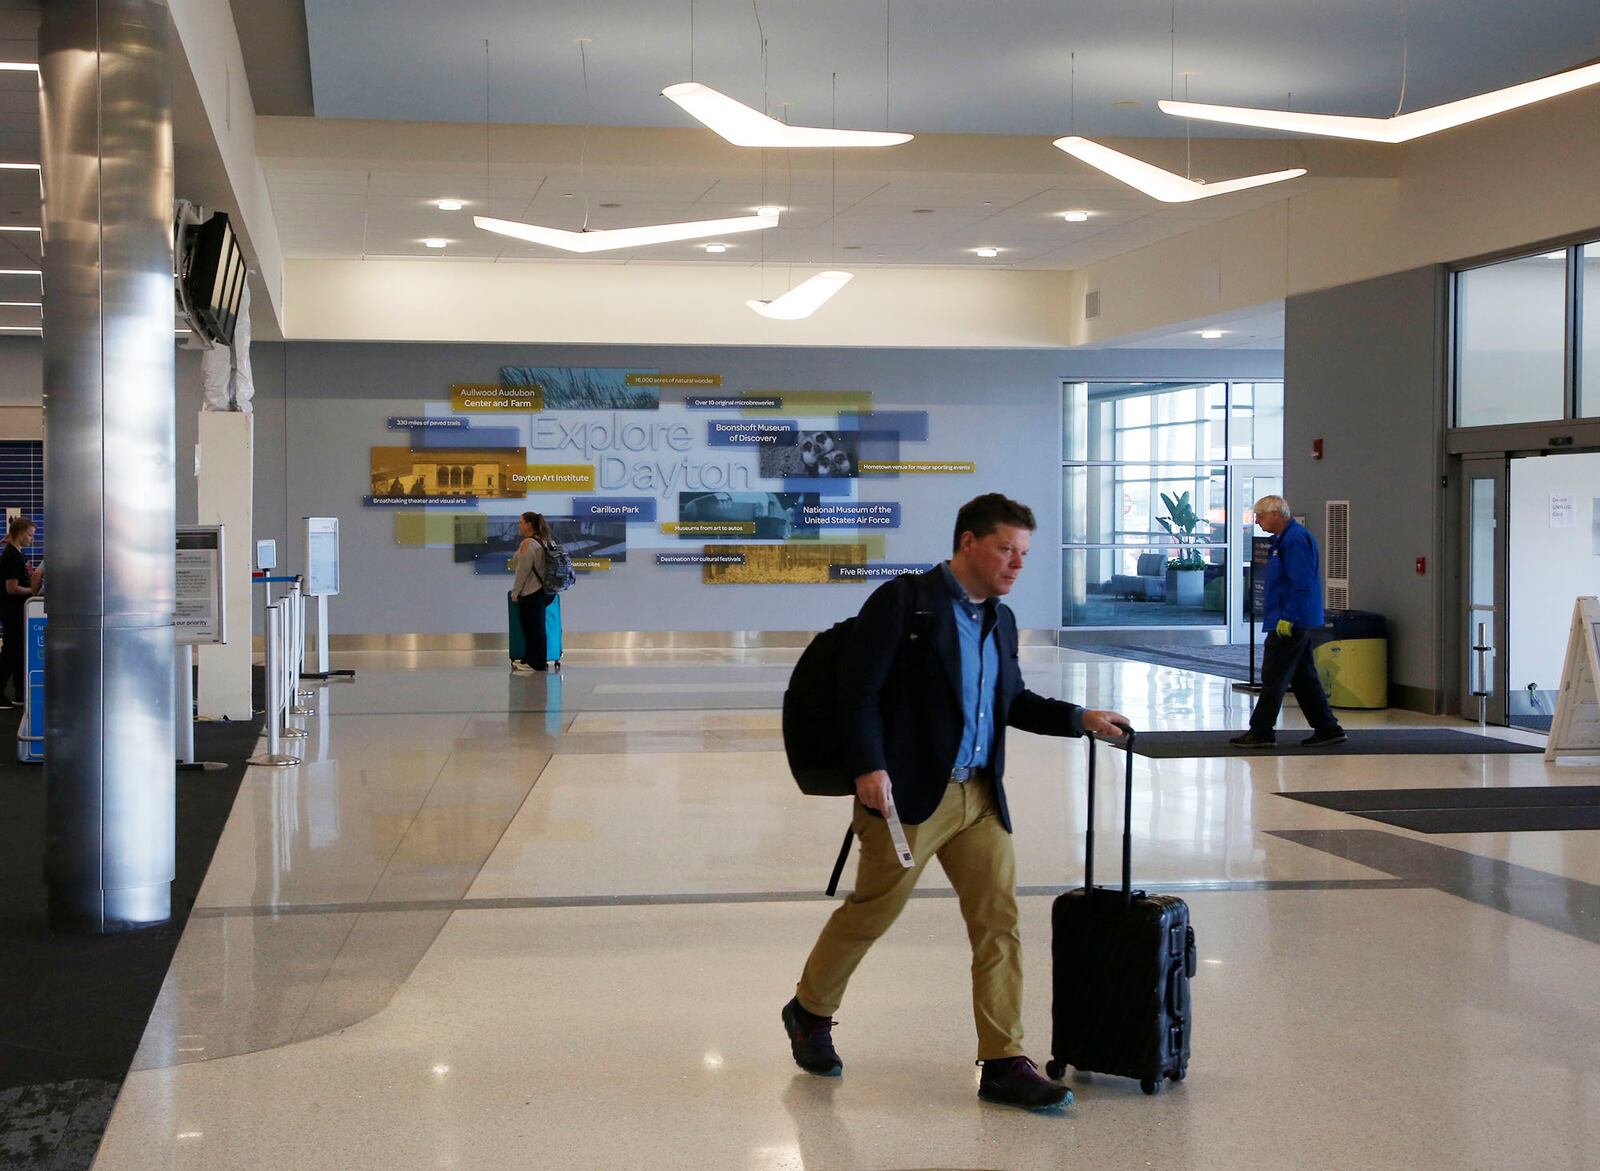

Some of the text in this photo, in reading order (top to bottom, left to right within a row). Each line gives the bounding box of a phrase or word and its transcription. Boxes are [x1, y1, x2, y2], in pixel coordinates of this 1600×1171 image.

[460, 389, 535, 397] Aullwood Audubon
[464, 399, 532, 407] Center and Farm
[531, 413, 694, 460] Explore
[729, 434, 777, 443] of Discovery
[512, 474, 589, 483] Dayton Art Institute
[599, 454, 751, 498] Dayton
[804, 516, 890, 524] United States Air Force
